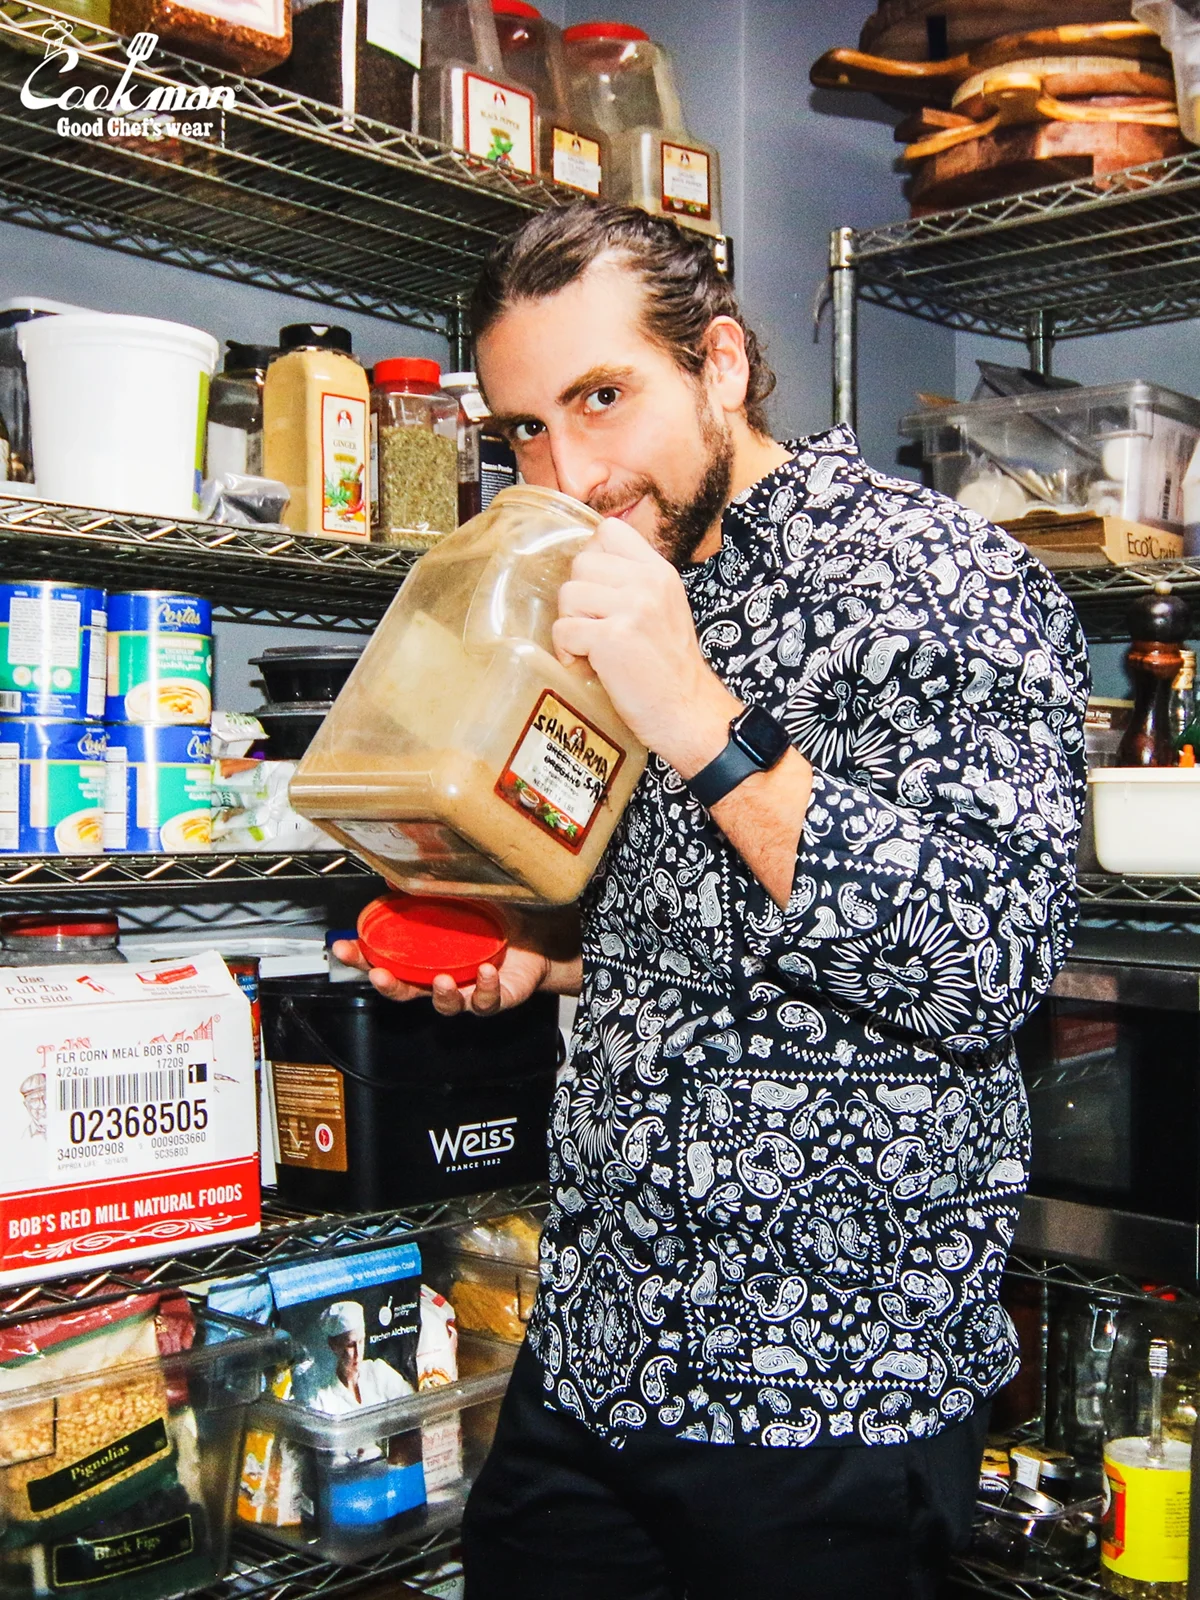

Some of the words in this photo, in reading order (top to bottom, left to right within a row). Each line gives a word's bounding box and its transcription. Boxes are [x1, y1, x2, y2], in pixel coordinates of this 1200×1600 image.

[333, 440, 357, 450] GINGER
[156, 603, 201, 627] Cortas
[532, 714, 609, 784] SHAWARMA
[16, 975, 45, 984] Use
[5, 985, 37, 995] Pull
[39, 984, 69, 993] Tab
[14, 996, 37, 1005] On
[40, 995, 73, 1004] Side
[56, 1052, 76, 1064] FLR
[80, 1049, 108, 1062] CORN
[112, 1046, 140, 1060] MEAL
[143, 1043, 173, 1057] BOB'S
[176, 1043, 190, 1054] RD
[157, 1057, 184, 1069] 17209
[56, 1066, 89, 1078] 4/24oz
[70, 1098, 208, 1144] 02368505
[151, 1132, 206, 1149] 0009053660
[428, 1117, 518, 1165] Weiss
[57, 1142, 125, 1161] 3409002908
[57, 1161, 82, 1171] APPROX
[446, 1161, 479, 1173] FRANCE
[482, 1157, 501, 1167] 1882
[8, 1213, 56, 1239] BOB'S
[60, 1208, 91, 1231] RED
[95, 1202, 130, 1225] MILL
[134, 1191, 196, 1218] NATURAL
[198, 1183, 243, 1207] FOODS
[369, 1332, 391, 1344] Kitchen
[70, 1444, 130, 1481] Pignolias
[93, 1541, 132, 1561] Black
[136, 1535, 161, 1549] Figs
